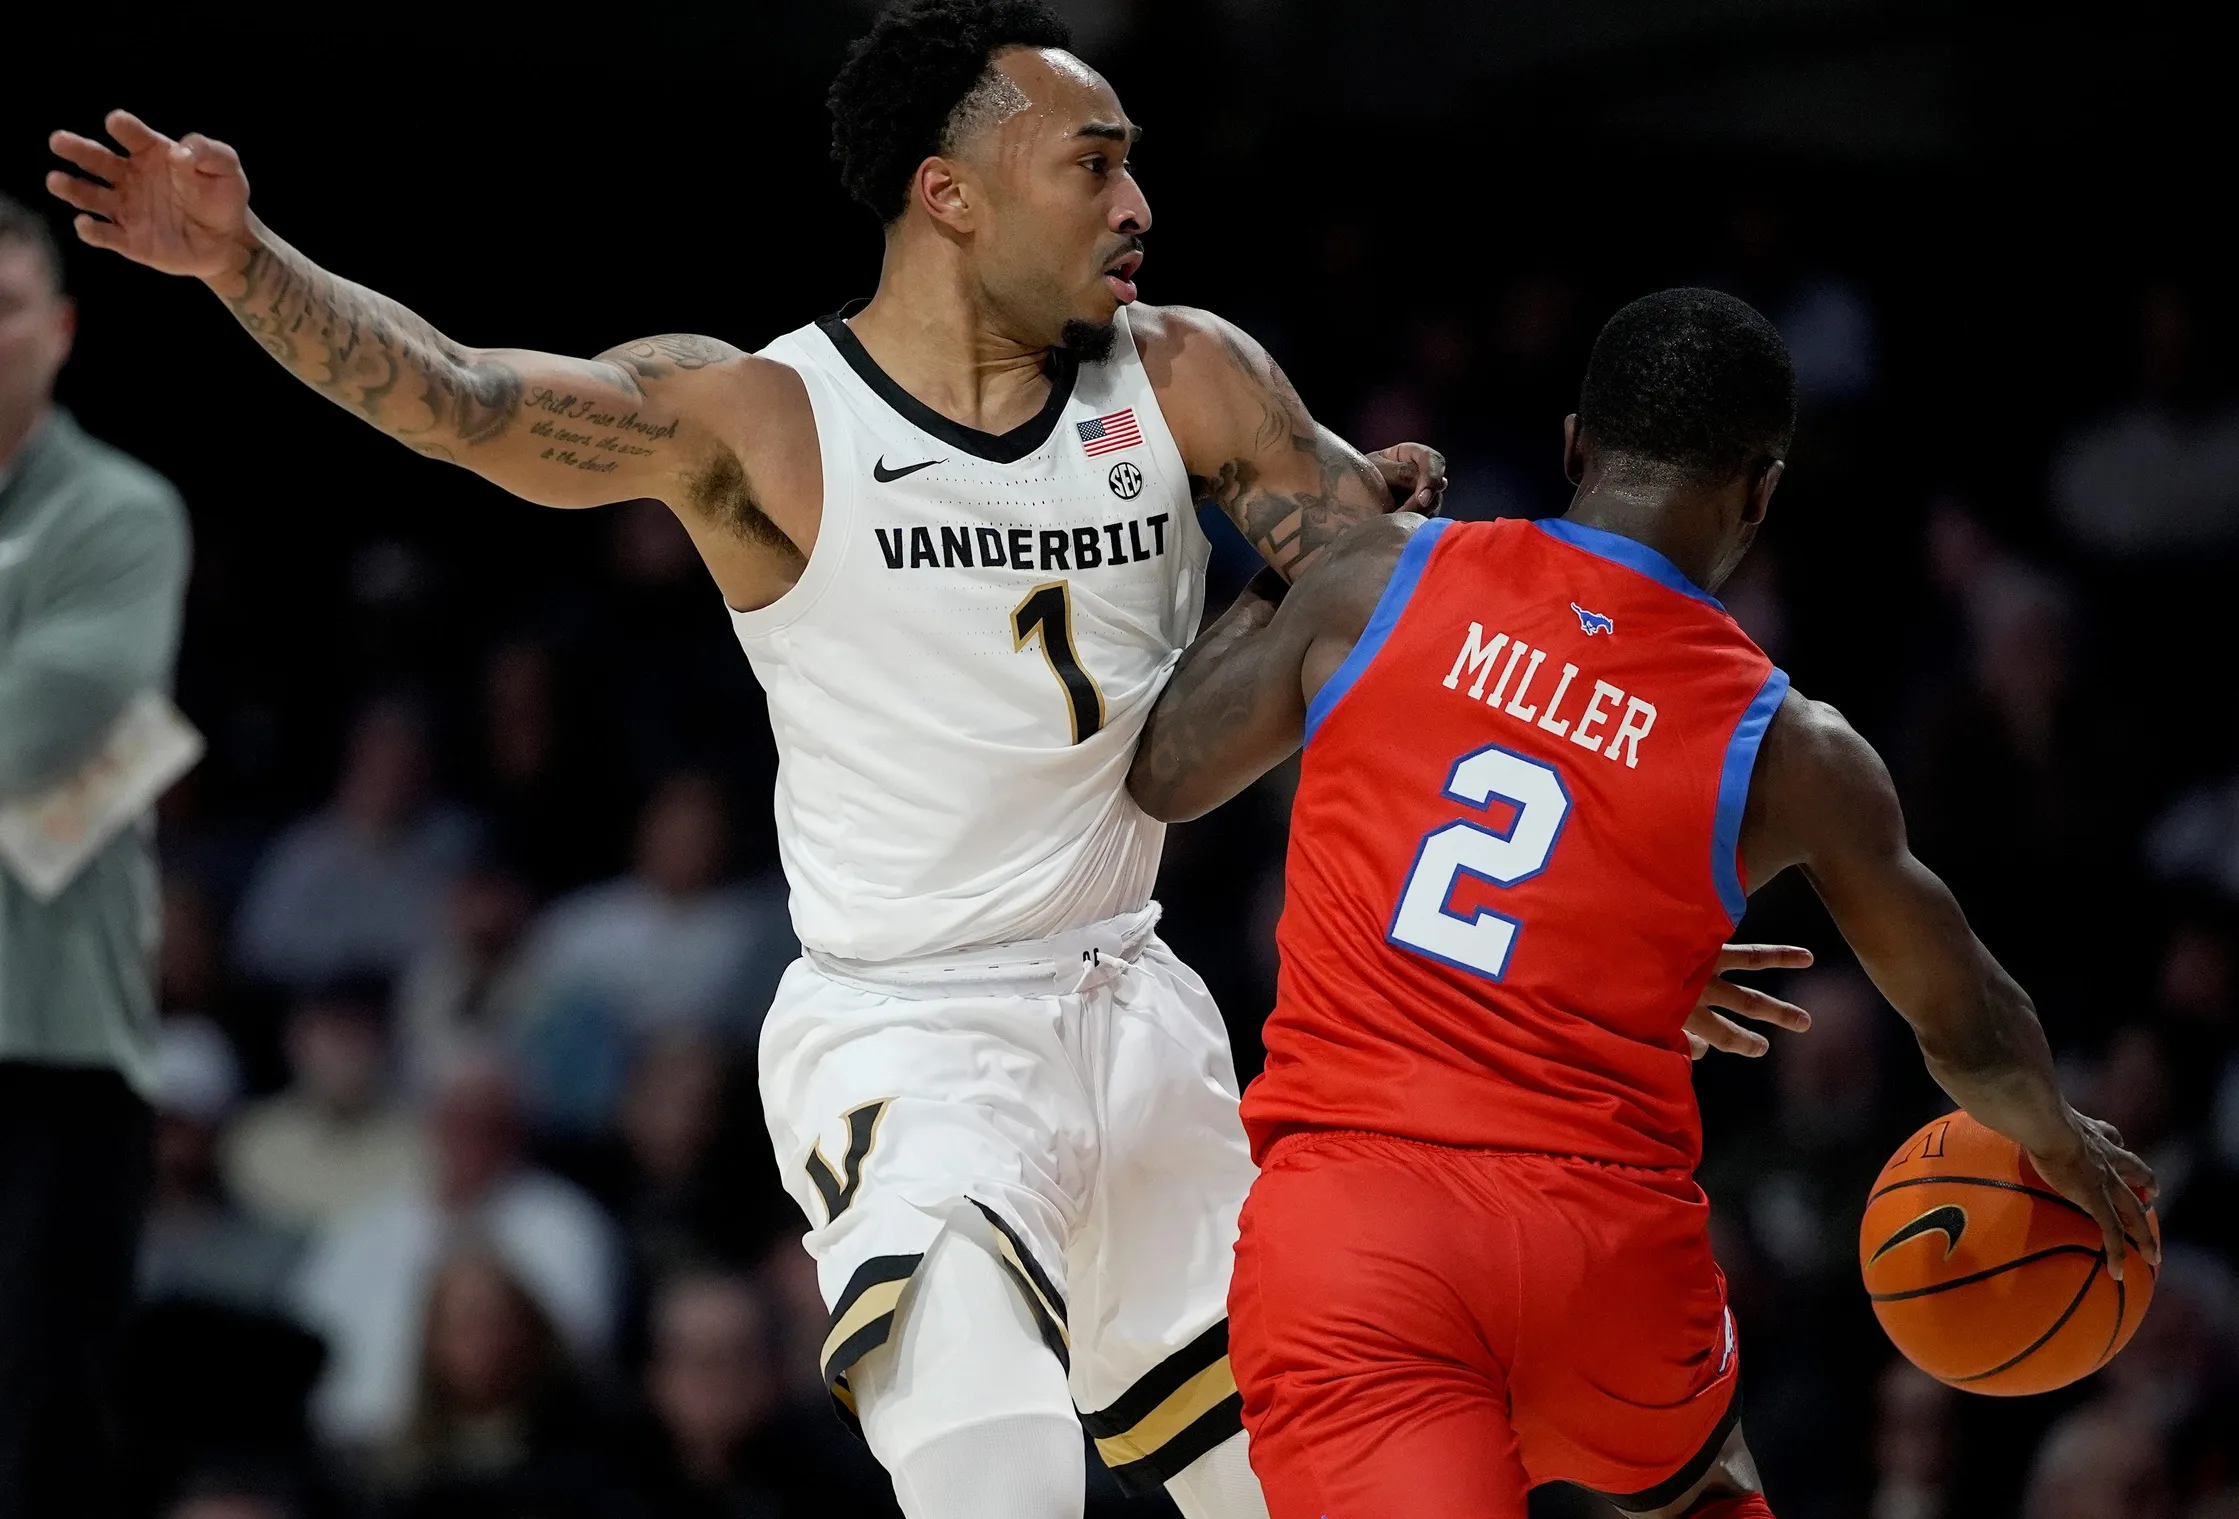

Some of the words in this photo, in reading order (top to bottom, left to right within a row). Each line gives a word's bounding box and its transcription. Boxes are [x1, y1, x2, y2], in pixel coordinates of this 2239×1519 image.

[524, 385, 577, 415] Still
[568, 400, 596, 419] I
[586, 411, 615, 427] rise
[616, 412, 680, 441] through
[530, 420, 554, 437] the
[1109, 462, 1142, 500] SEC
[874, 512, 1170, 571] VANDERBILT
[1009, 578, 1106, 746] 1
[1442, 620, 1658, 769] MILLER
[1385, 741, 1573, 982] 2
[804, 1096, 901, 1229] V
